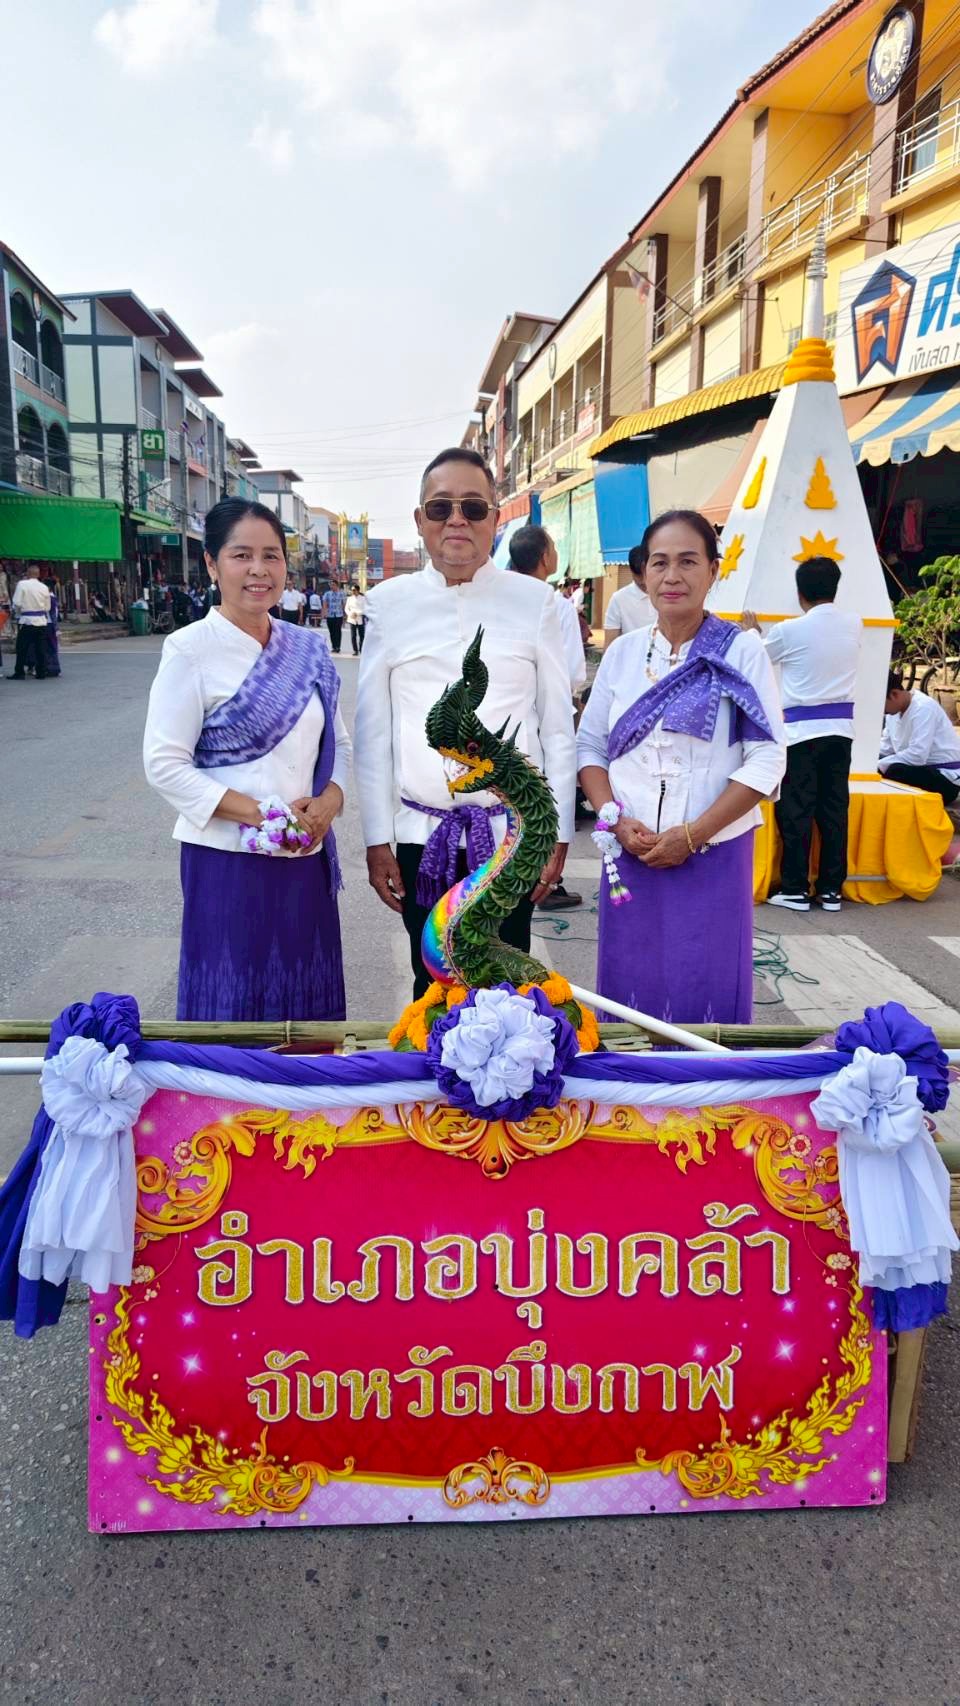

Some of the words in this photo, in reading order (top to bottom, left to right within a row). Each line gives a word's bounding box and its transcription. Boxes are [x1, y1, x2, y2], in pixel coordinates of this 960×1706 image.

[143, 434, 163, 450] ยา
[194, 1202, 790, 1329] อำเภอบุ่งคล้า
[246, 1340, 742, 1422] จังหวัดบึงกาฬ
